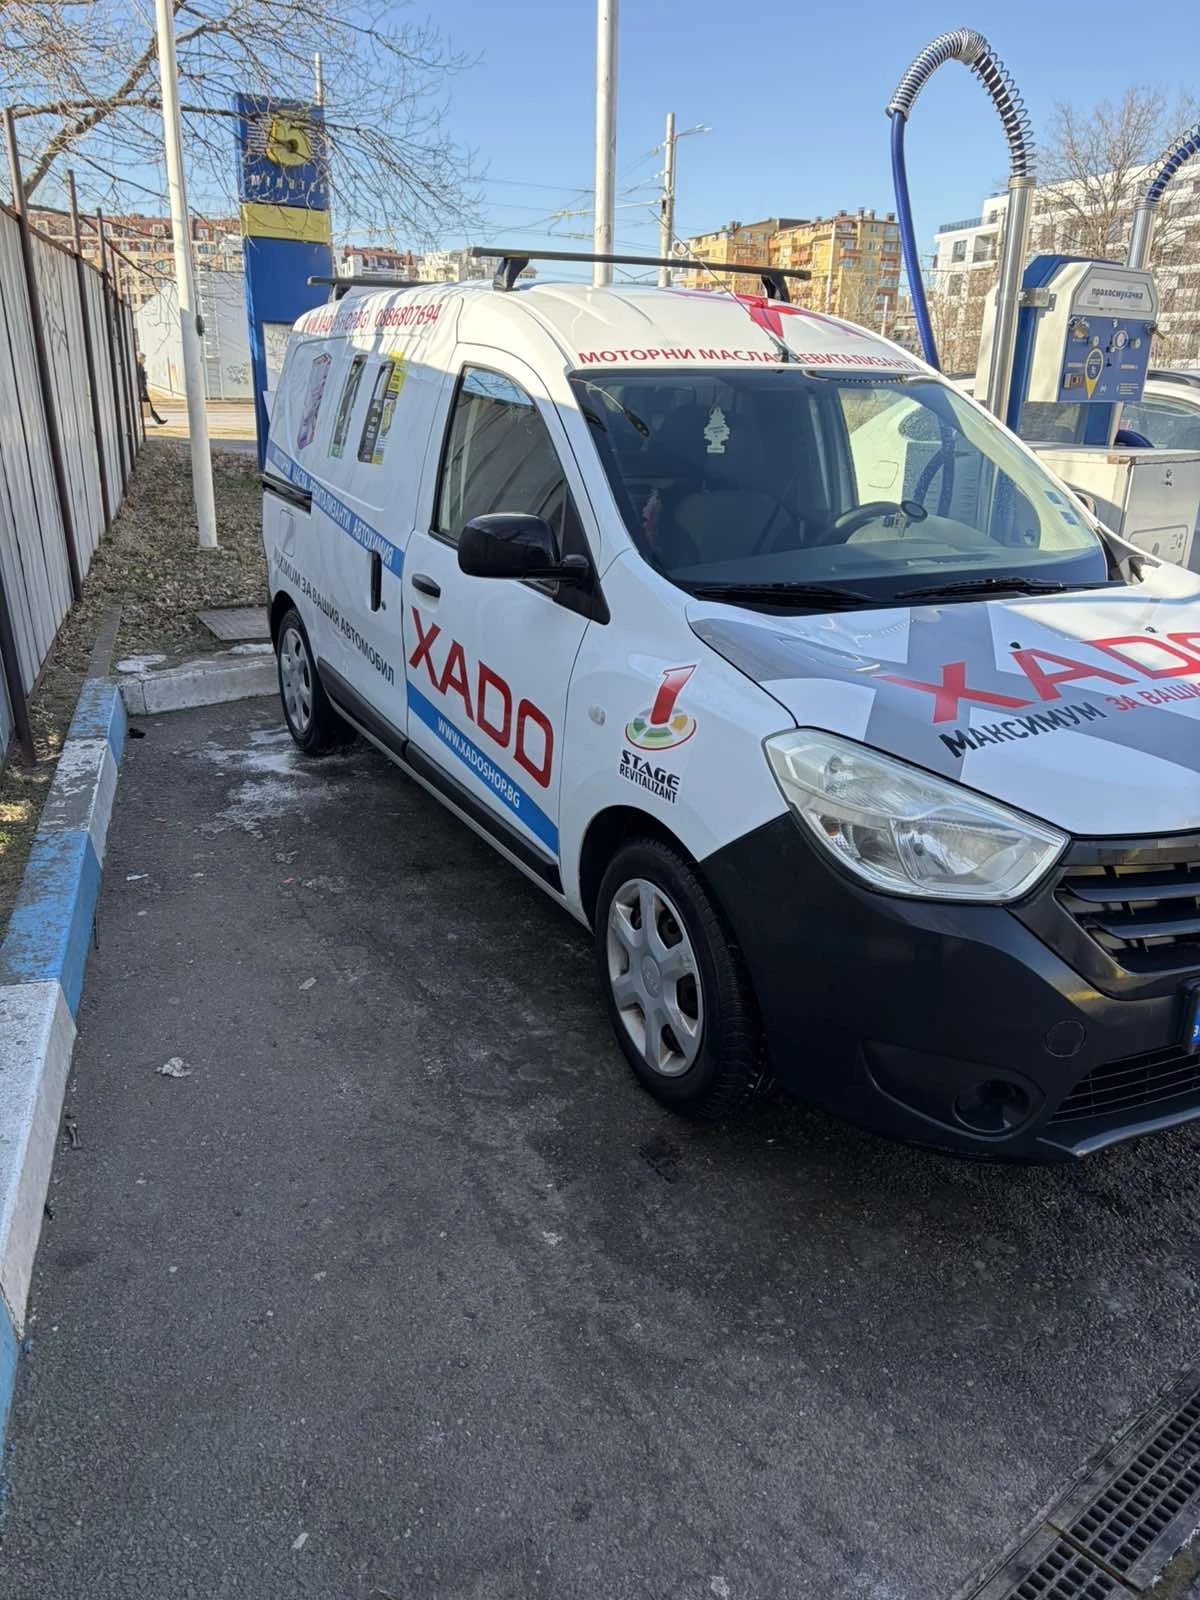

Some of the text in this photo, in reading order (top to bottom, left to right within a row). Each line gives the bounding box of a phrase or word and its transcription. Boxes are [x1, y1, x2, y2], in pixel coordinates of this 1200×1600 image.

[375, 303, 443, 328] 0886807694
[578, 348, 696, 365] МОТОРНИ
[698, 349, 779, 363] МАСЛА
[301, 574, 313, 599] ЗА
[311, 590, 341, 628] ВАШИЯ
[340, 617, 394, 687] АВТОМОБИЛ
[409, 606, 554, 788] XADO
[651, 664, 697, 725] 1
[938, 702, 1107, 758] МАКСИМУМ
[1104, 694, 1143, 711] ЗА
[438, 716, 520, 808] WWW.XADOSHOP.BG
[619, 763, 678, 805] REVITALIZANT
[620, 749, 681, 791] STAGE
